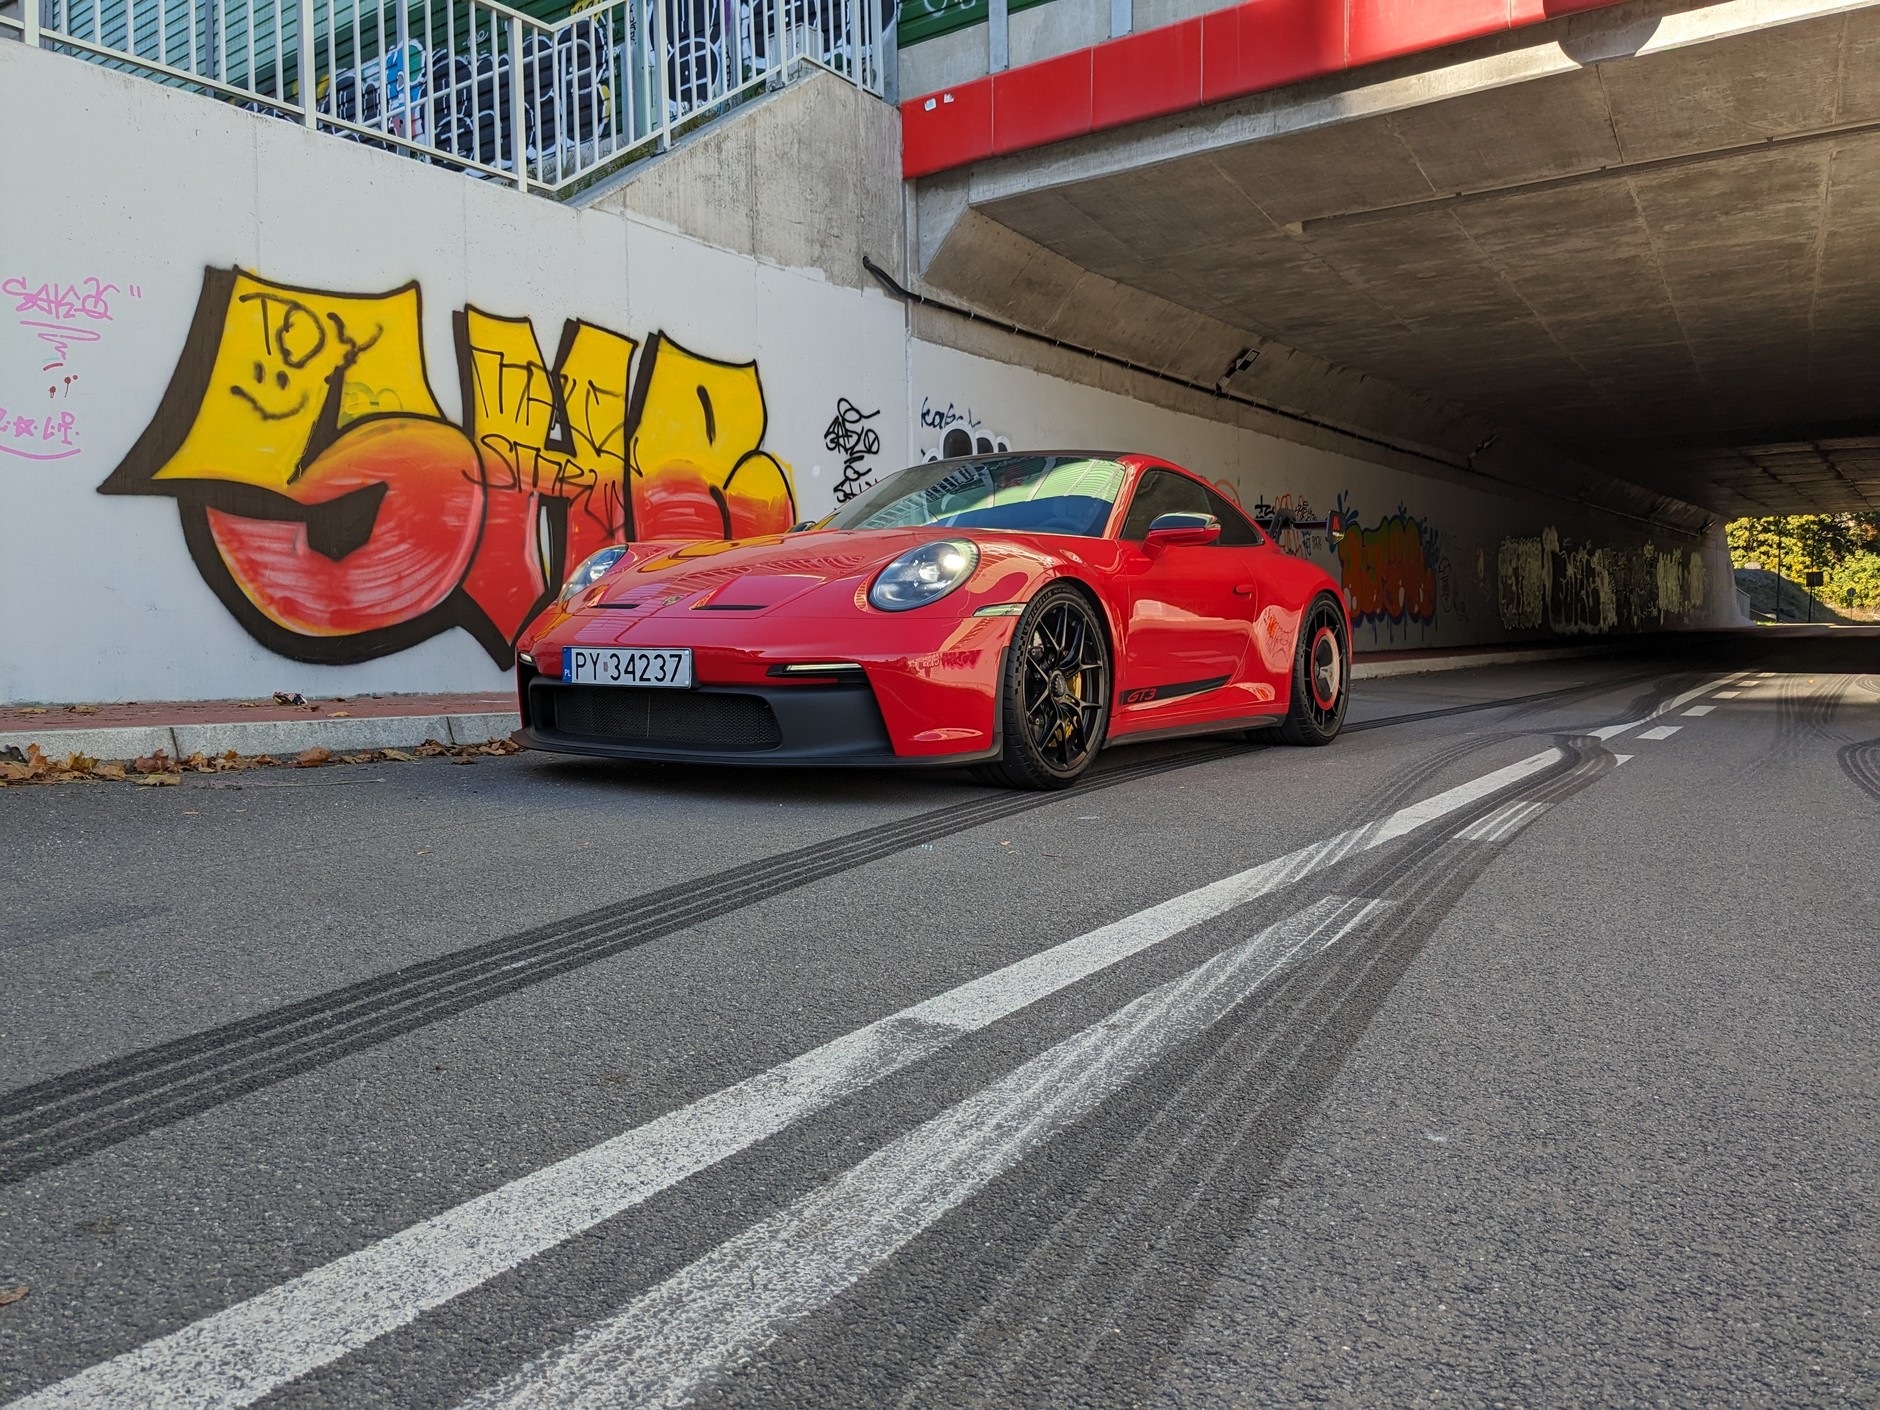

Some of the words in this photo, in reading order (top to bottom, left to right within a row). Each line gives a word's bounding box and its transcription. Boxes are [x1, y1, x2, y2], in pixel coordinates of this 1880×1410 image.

[239, 292, 383, 373] TOY
[564, 668, 571, 677] PL
[575, 652, 600, 680] PY
[609, 653, 682, 682] 34237
[1127, 688, 1157, 702] GT3
